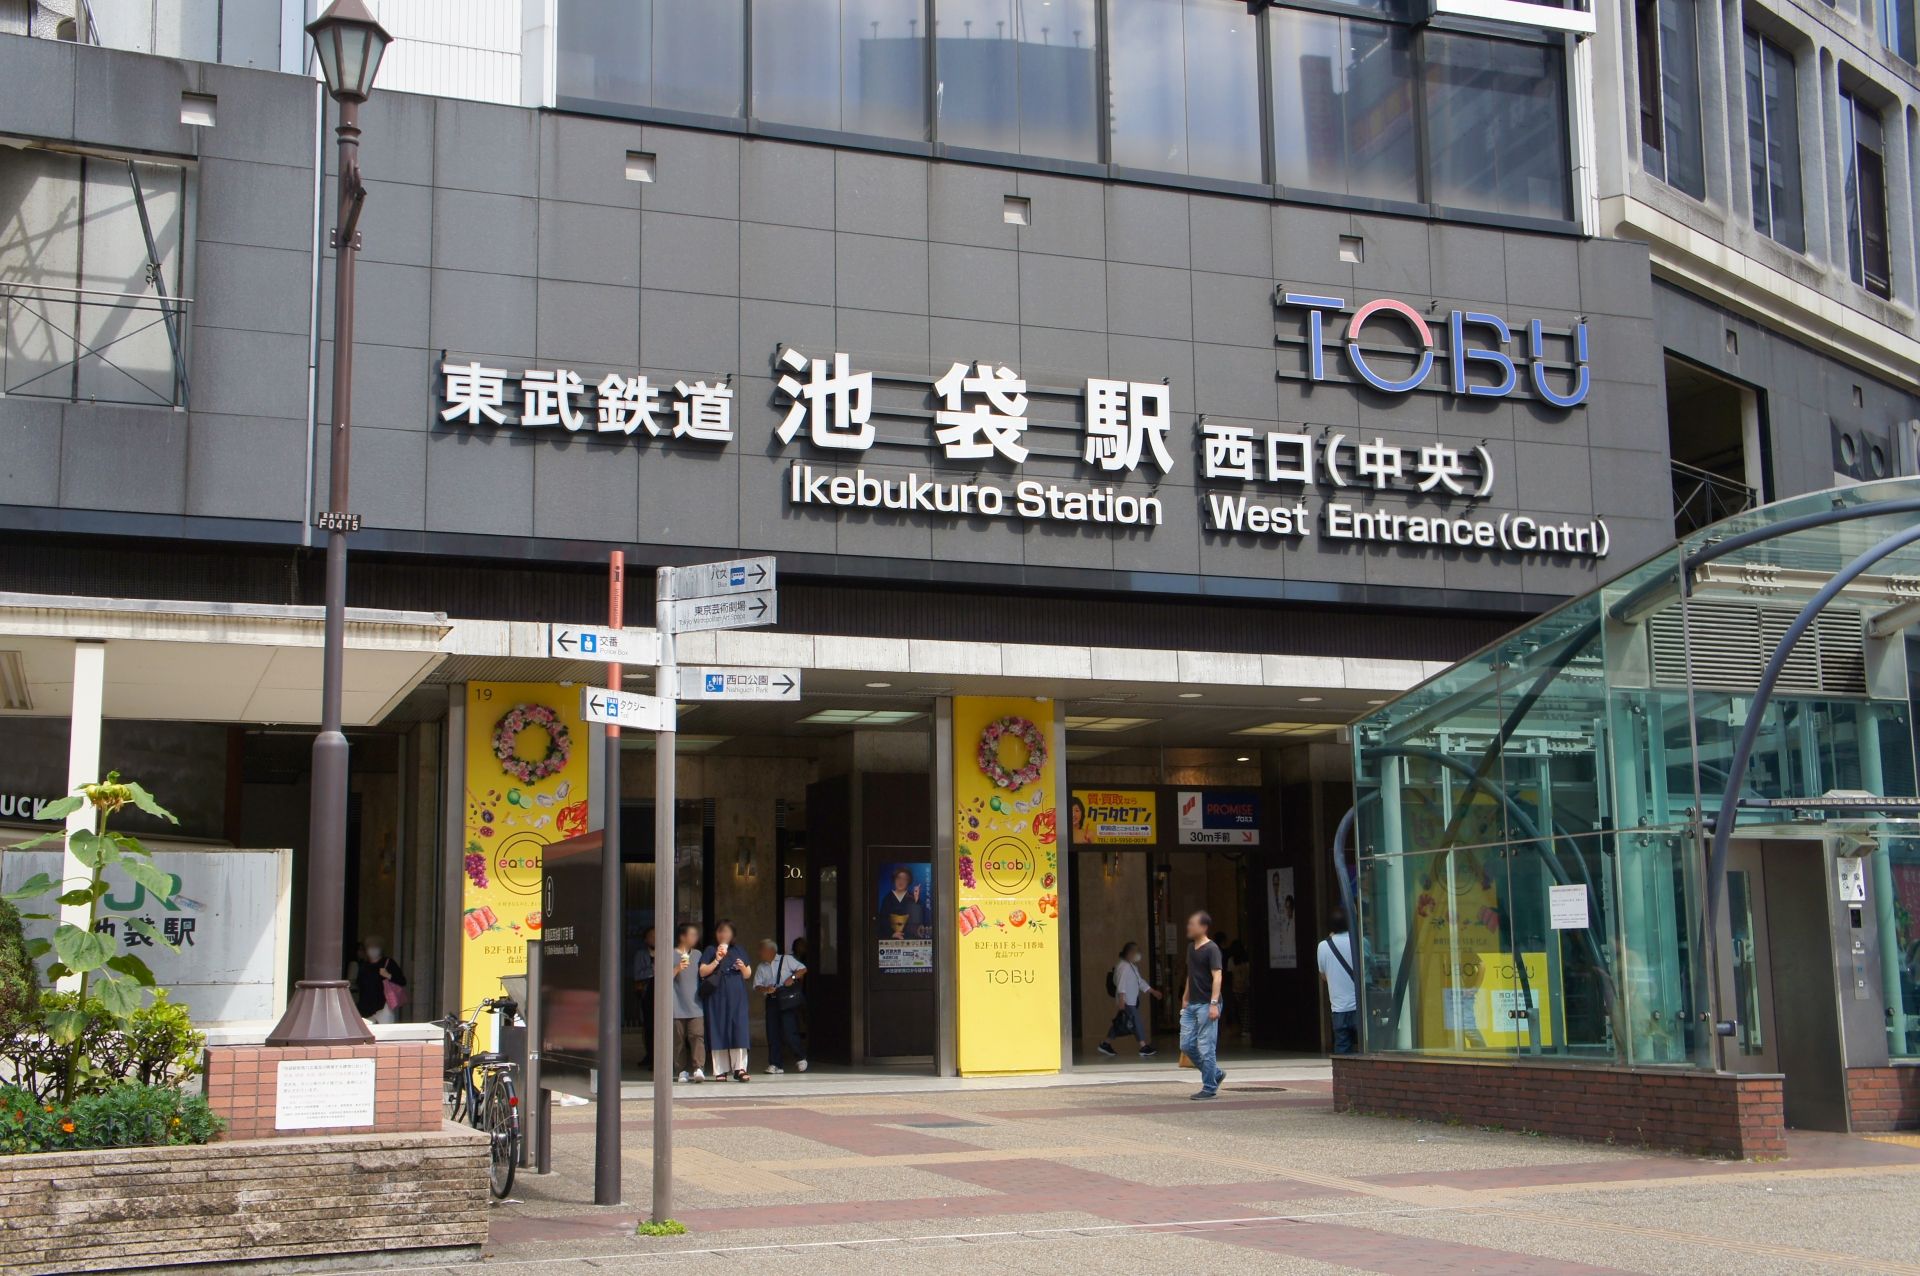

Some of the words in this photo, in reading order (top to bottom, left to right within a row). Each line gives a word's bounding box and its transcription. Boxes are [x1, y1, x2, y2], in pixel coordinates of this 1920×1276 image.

[1286, 293, 1590, 408] TOBU
[440, 360, 735, 443] 東武鉄道
[774, 348, 1176, 476] 池袋駅
[790, 464, 1003, 514] Ikebukuro
[1015, 480, 1163, 525] Station
[1208, 493, 1310, 537] West
[319, 518, 359, 530] F0415
[711, 568, 728, 580] バス
[694, 600, 746, 616] 東京芸術劇場
[600, 636, 618, 647] 交番
[726, 674, 769, 686] 西口公園
[475, 688, 492, 701] 19
[620, 700, 647, 711] タクシー
[1207, 803, 1254, 815] PROMISE
[984, 859, 1032, 871] eatobu
[985, 969, 1035, 984] TOBU
